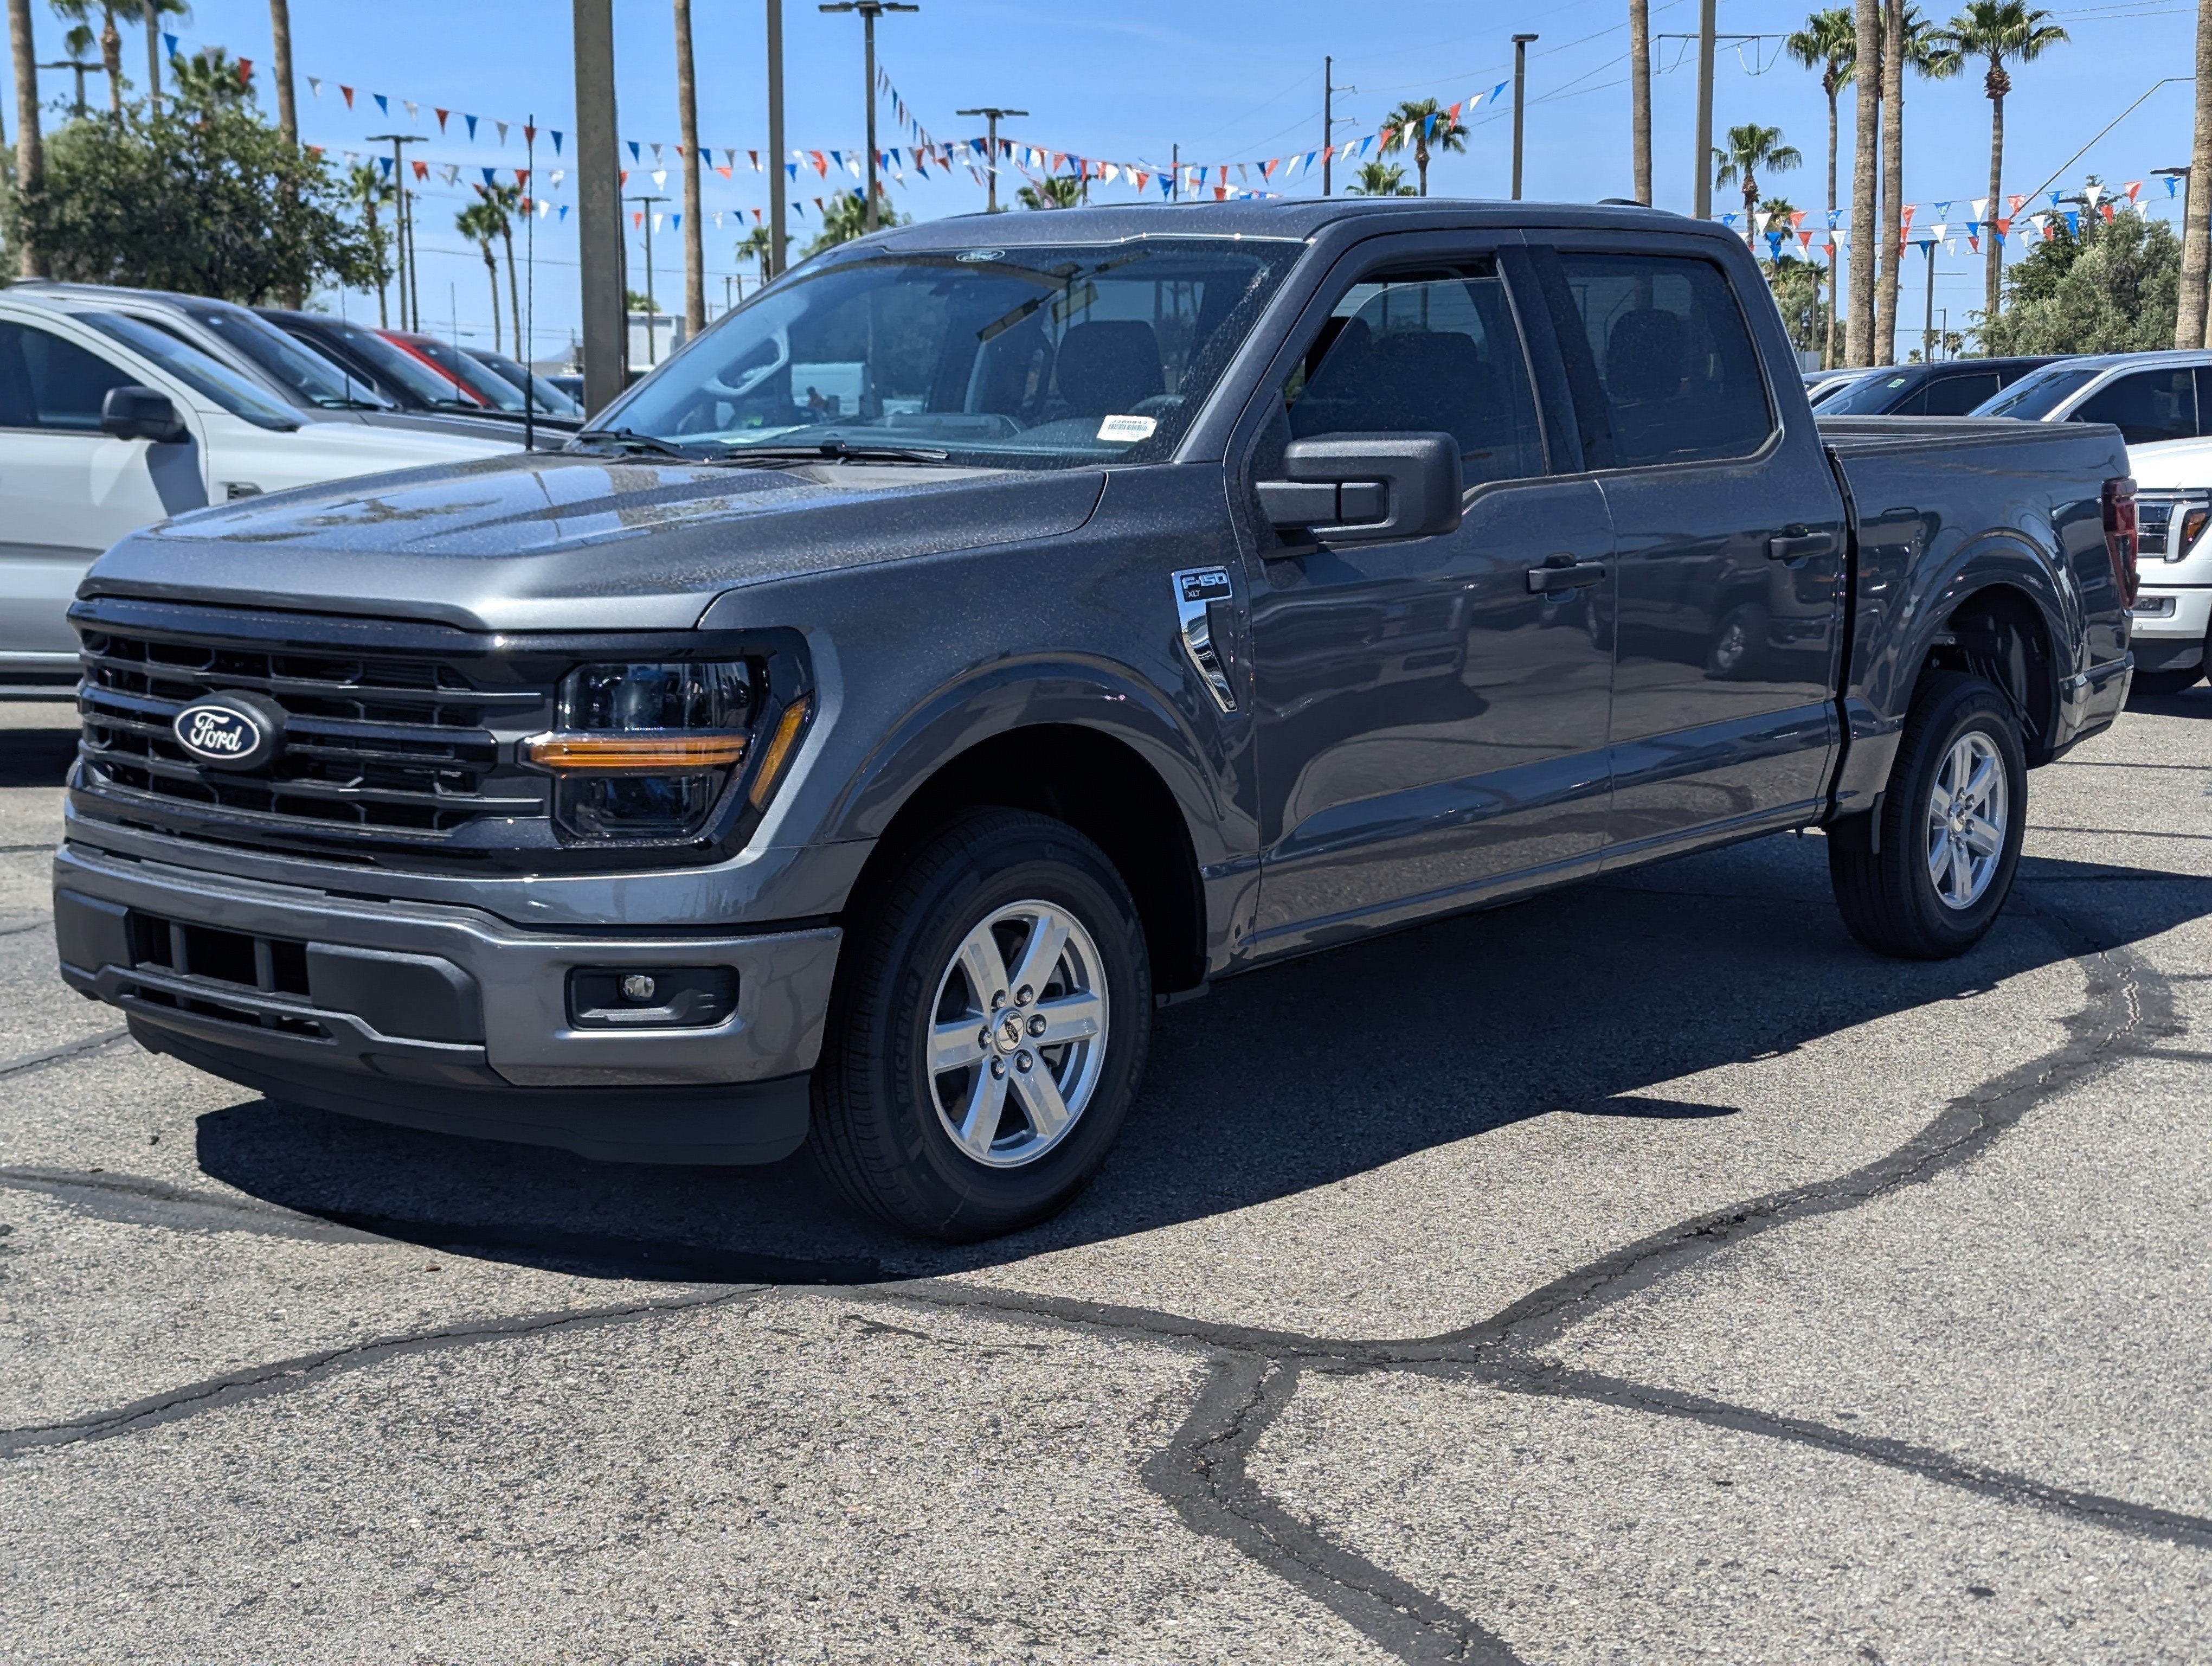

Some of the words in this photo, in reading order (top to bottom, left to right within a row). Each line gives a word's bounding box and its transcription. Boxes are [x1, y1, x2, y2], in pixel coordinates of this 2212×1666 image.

[1182, 572, 1228, 589] F-150
[1187, 589, 1200, 598] XLT
[190, 712, 243, 751] Ford
[895, 975, 918, 1104] MICHELIN
[1007, 1024, 1018, 1041] Ford
